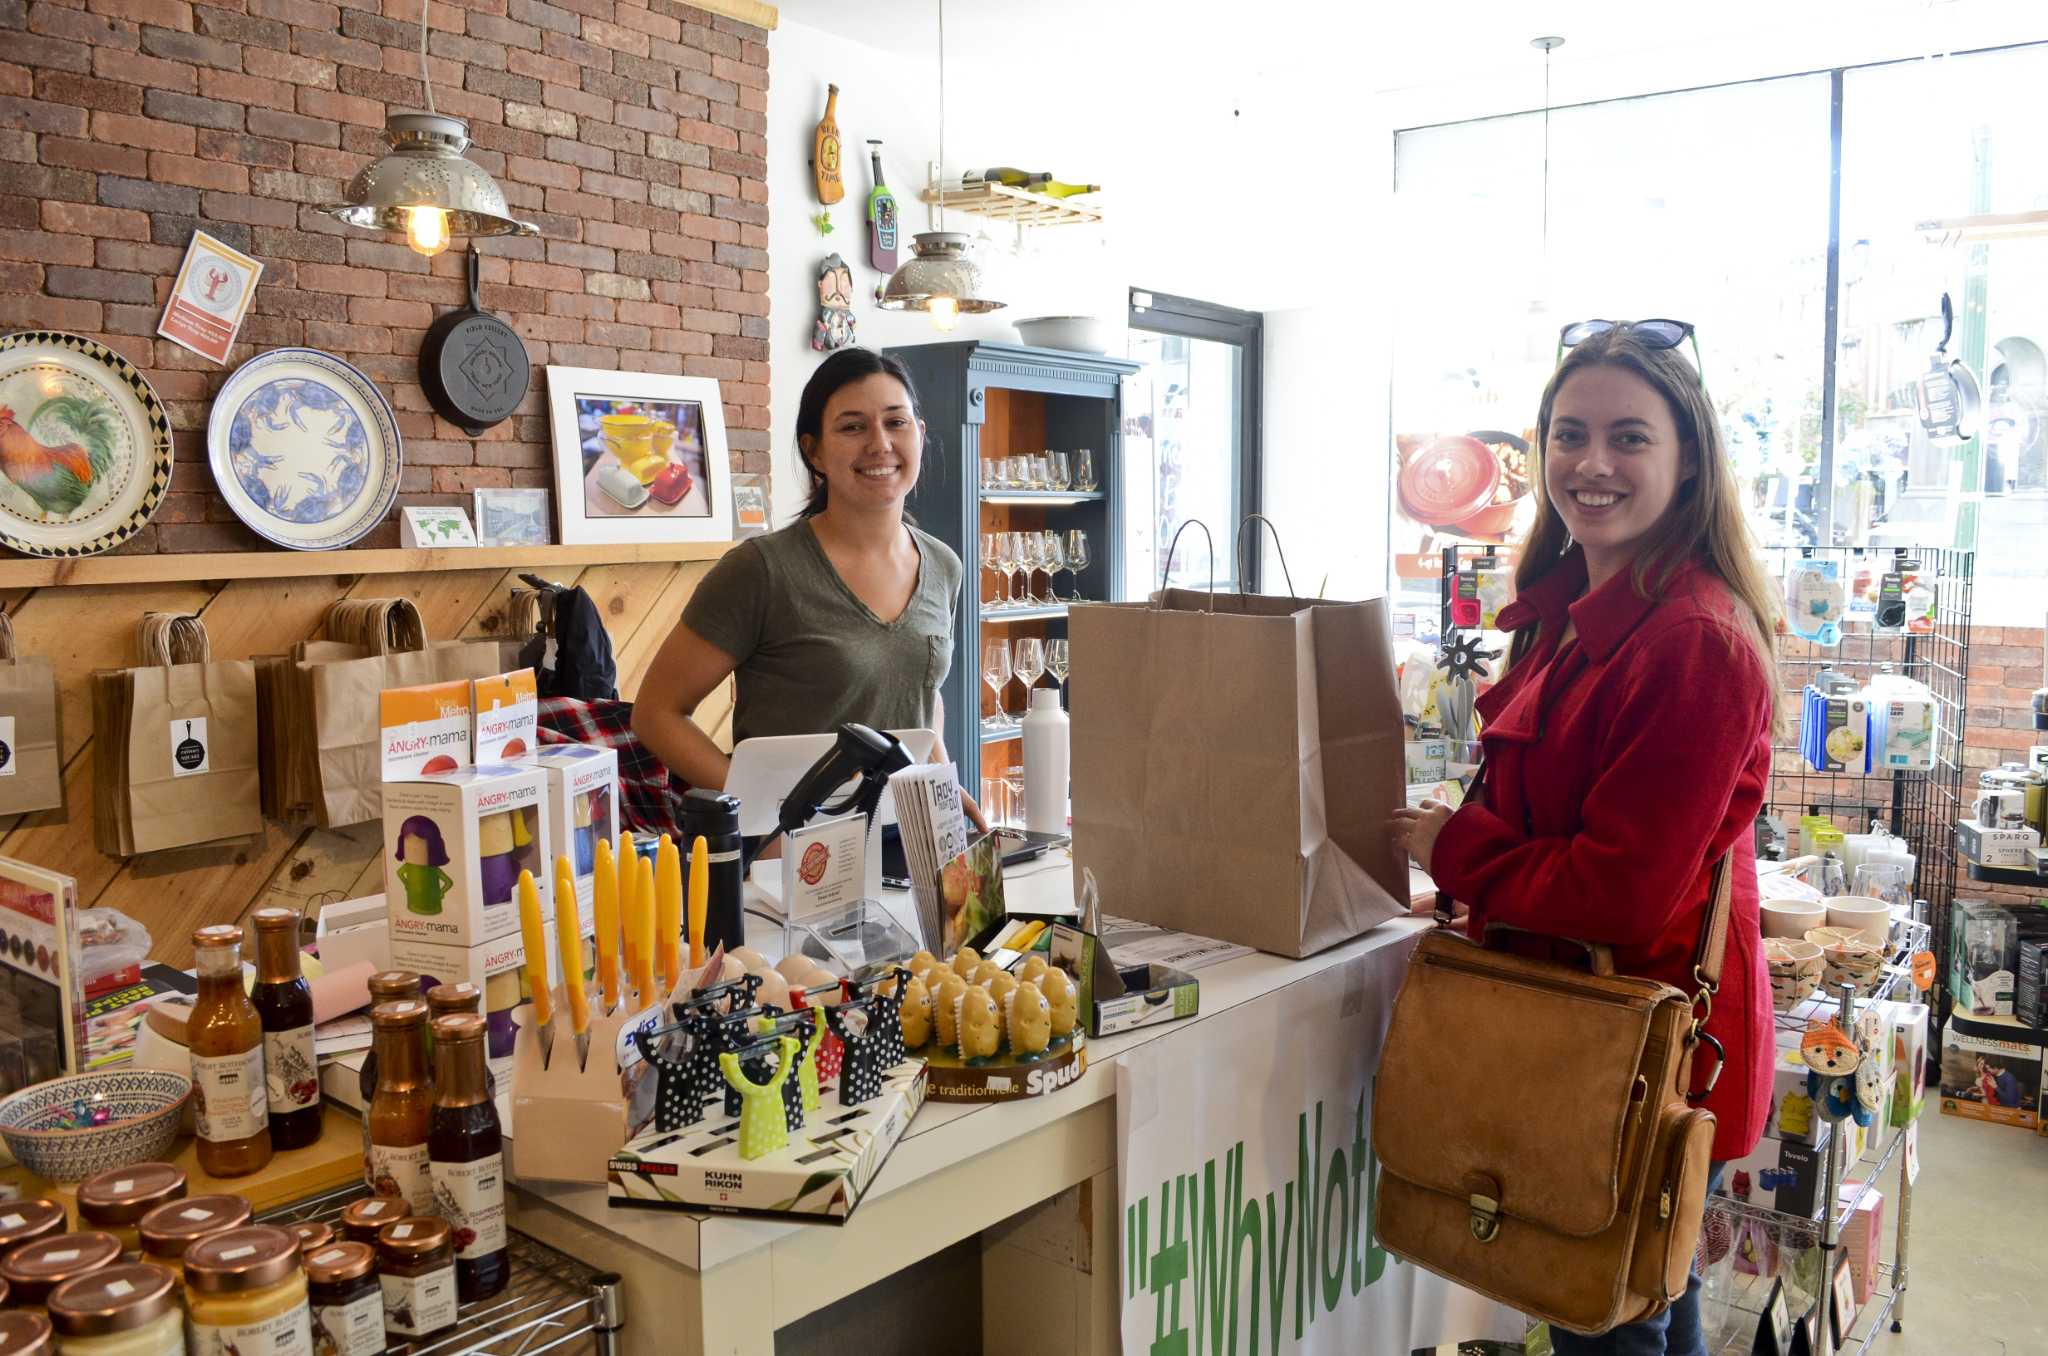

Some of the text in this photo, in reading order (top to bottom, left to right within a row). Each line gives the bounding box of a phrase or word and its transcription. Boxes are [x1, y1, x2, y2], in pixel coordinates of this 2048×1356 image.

[1992, 833, 2030, 841] SPARQ
[1985, 854, 1993, 863] 2
[608, 1161, 638, 1172] SWISS
[704, 1170, 743, 1182] KUHN
[704, 1179, 743, 1190] RIKON
